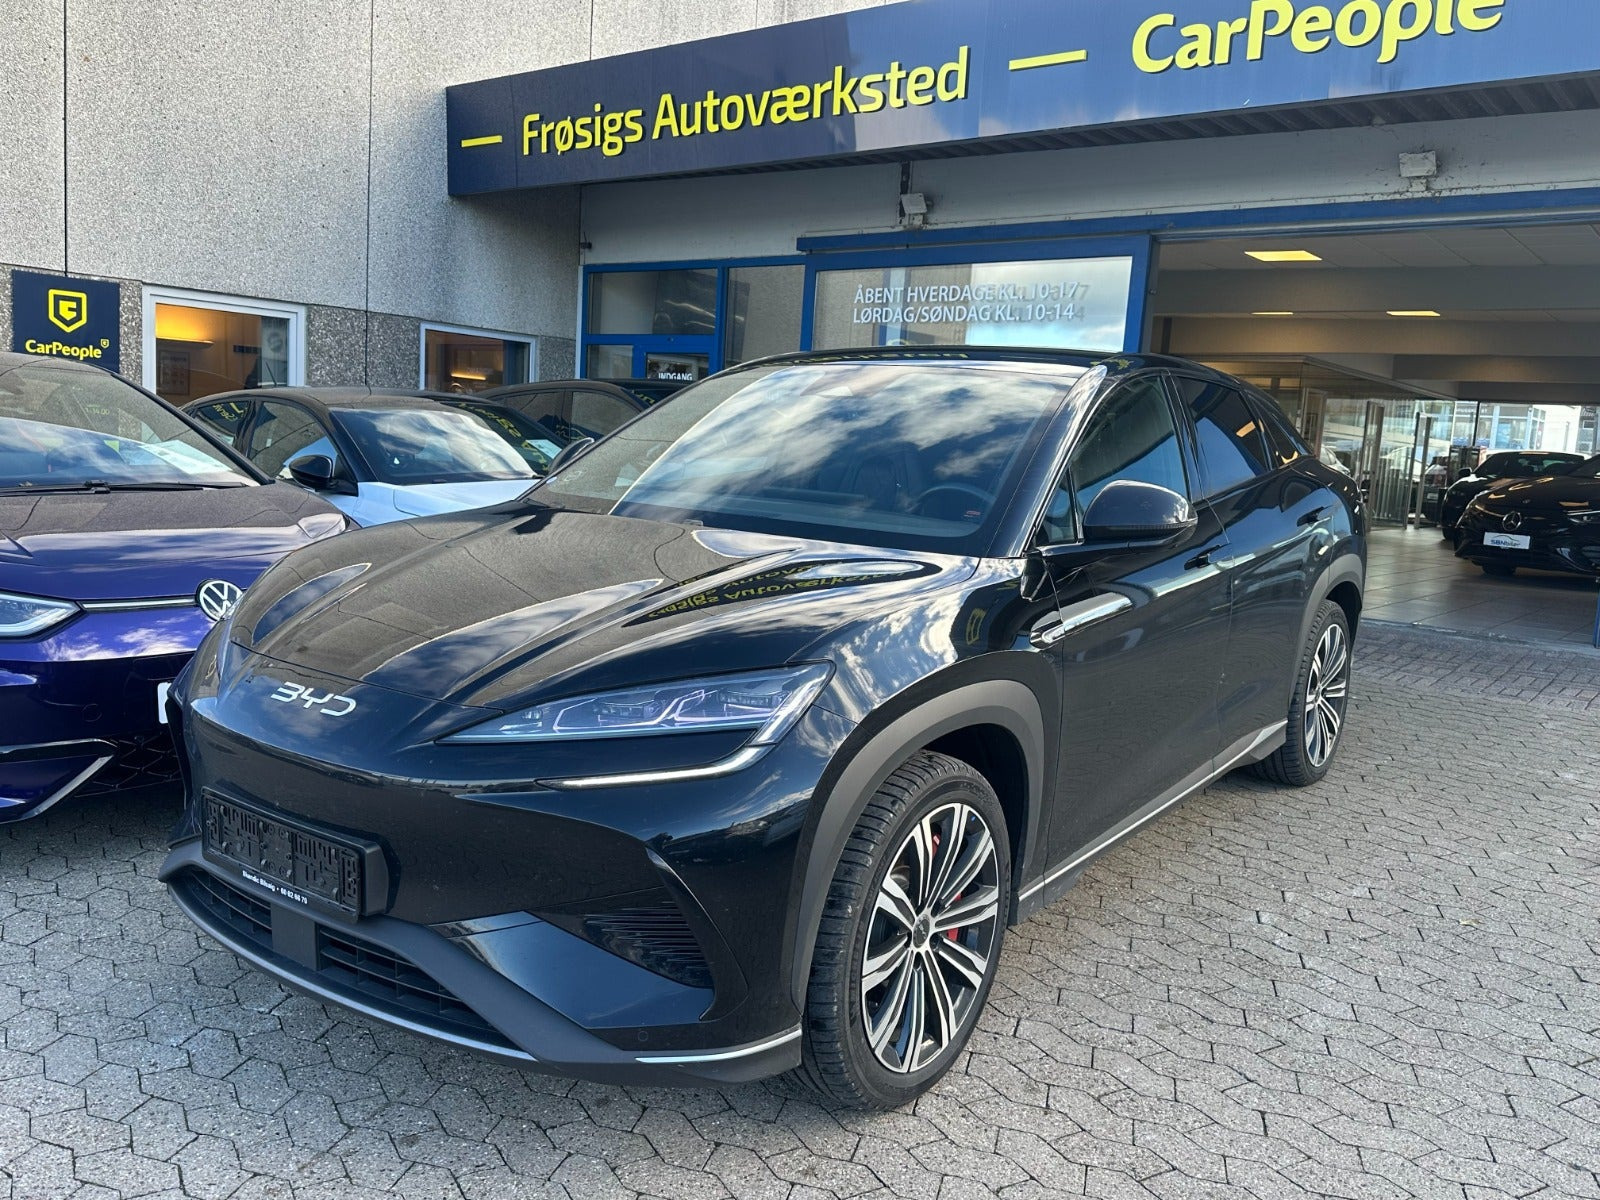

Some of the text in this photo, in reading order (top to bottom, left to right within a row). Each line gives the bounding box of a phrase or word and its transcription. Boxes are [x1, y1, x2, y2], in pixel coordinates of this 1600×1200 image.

[522, 45, 970, 157] Frøsigs Autoværksted
[854, 281, 1079, 304] ÅBENT HVERDAGE KL. 10-17
[853, 302, 1075, 324] LØRDAG/SØNDAG KL. 10-14
[25, 339, 102, 361] CarPeople
[658, 372, 693, 381] INDGANG
[270, 681, 357, 717] BYD
